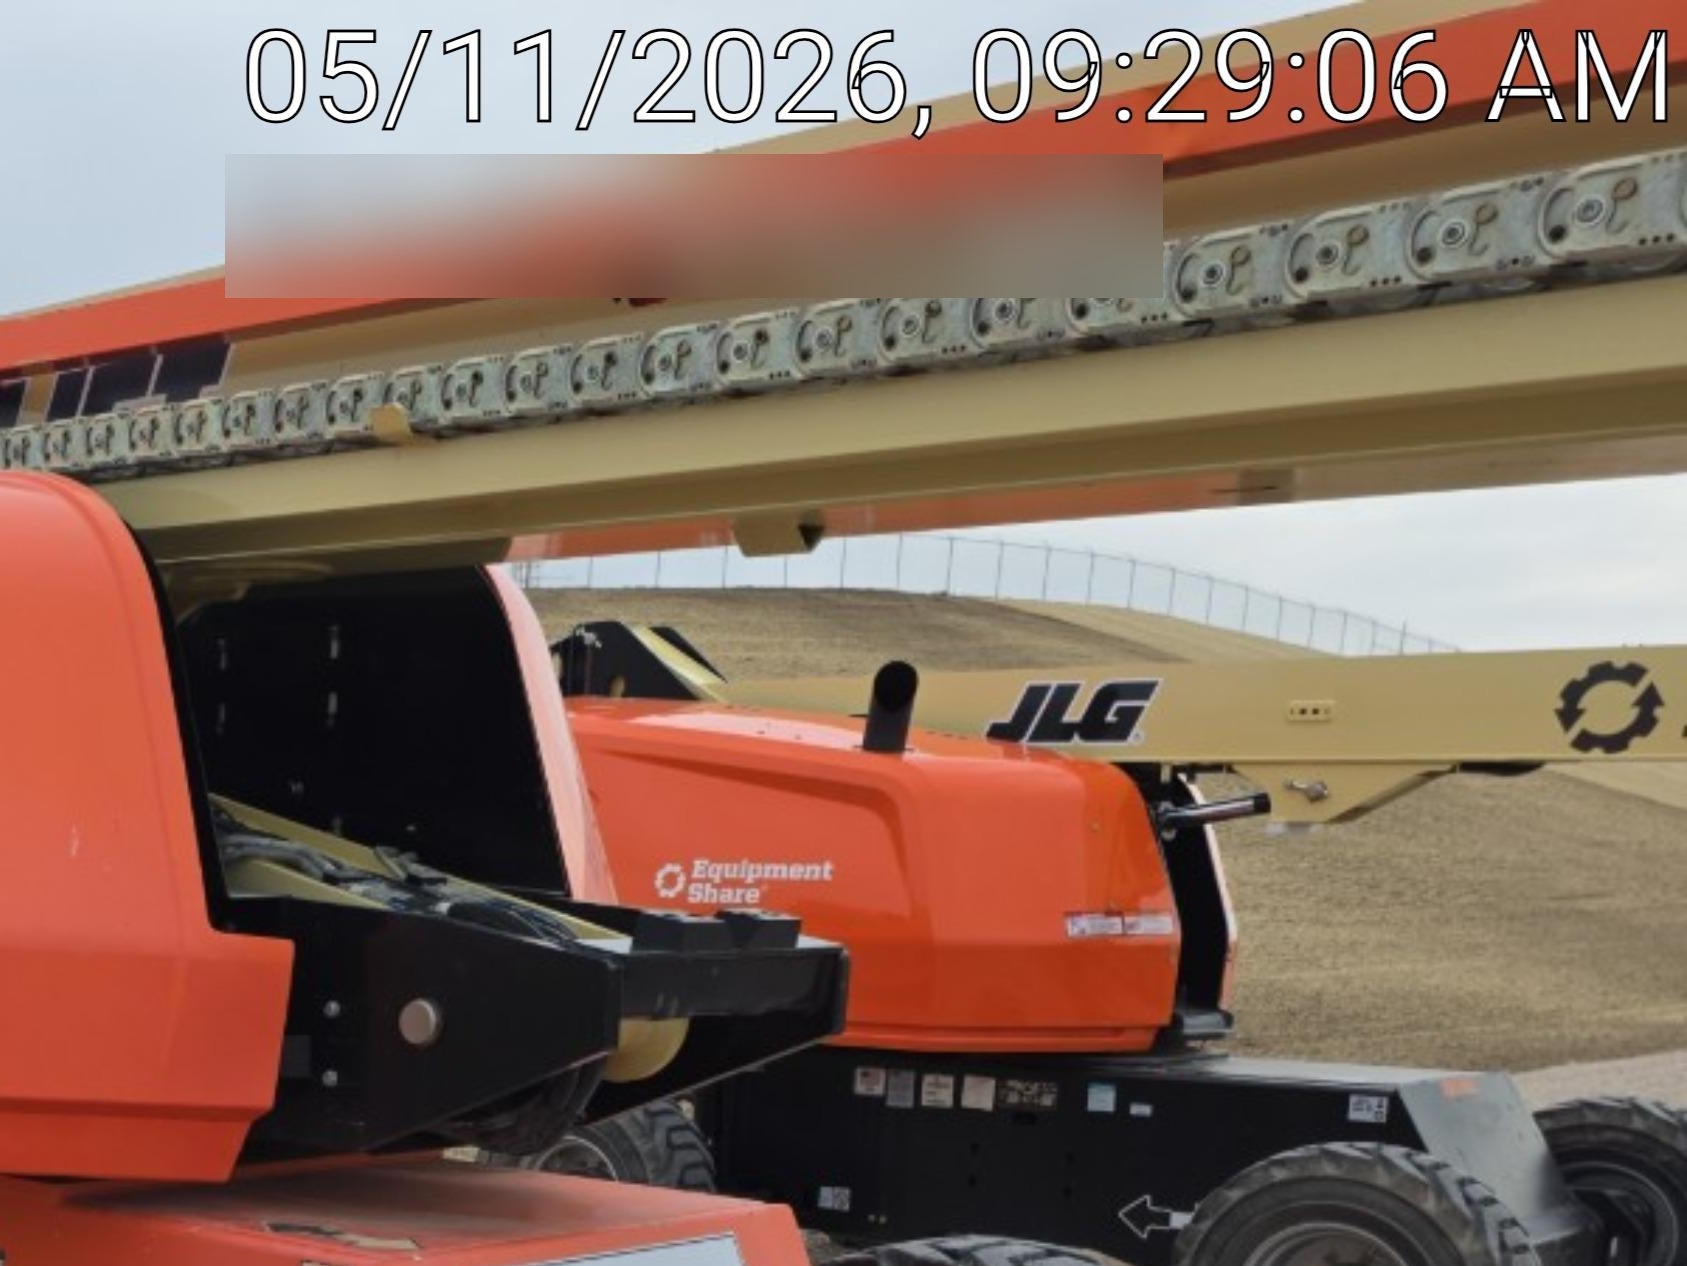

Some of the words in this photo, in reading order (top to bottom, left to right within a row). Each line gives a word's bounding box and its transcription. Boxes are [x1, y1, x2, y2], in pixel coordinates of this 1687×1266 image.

[985, 679, 1162, 744] JLG
[691, 859, 834, 883] Equipment
[687, 882, 760, 903] Share
